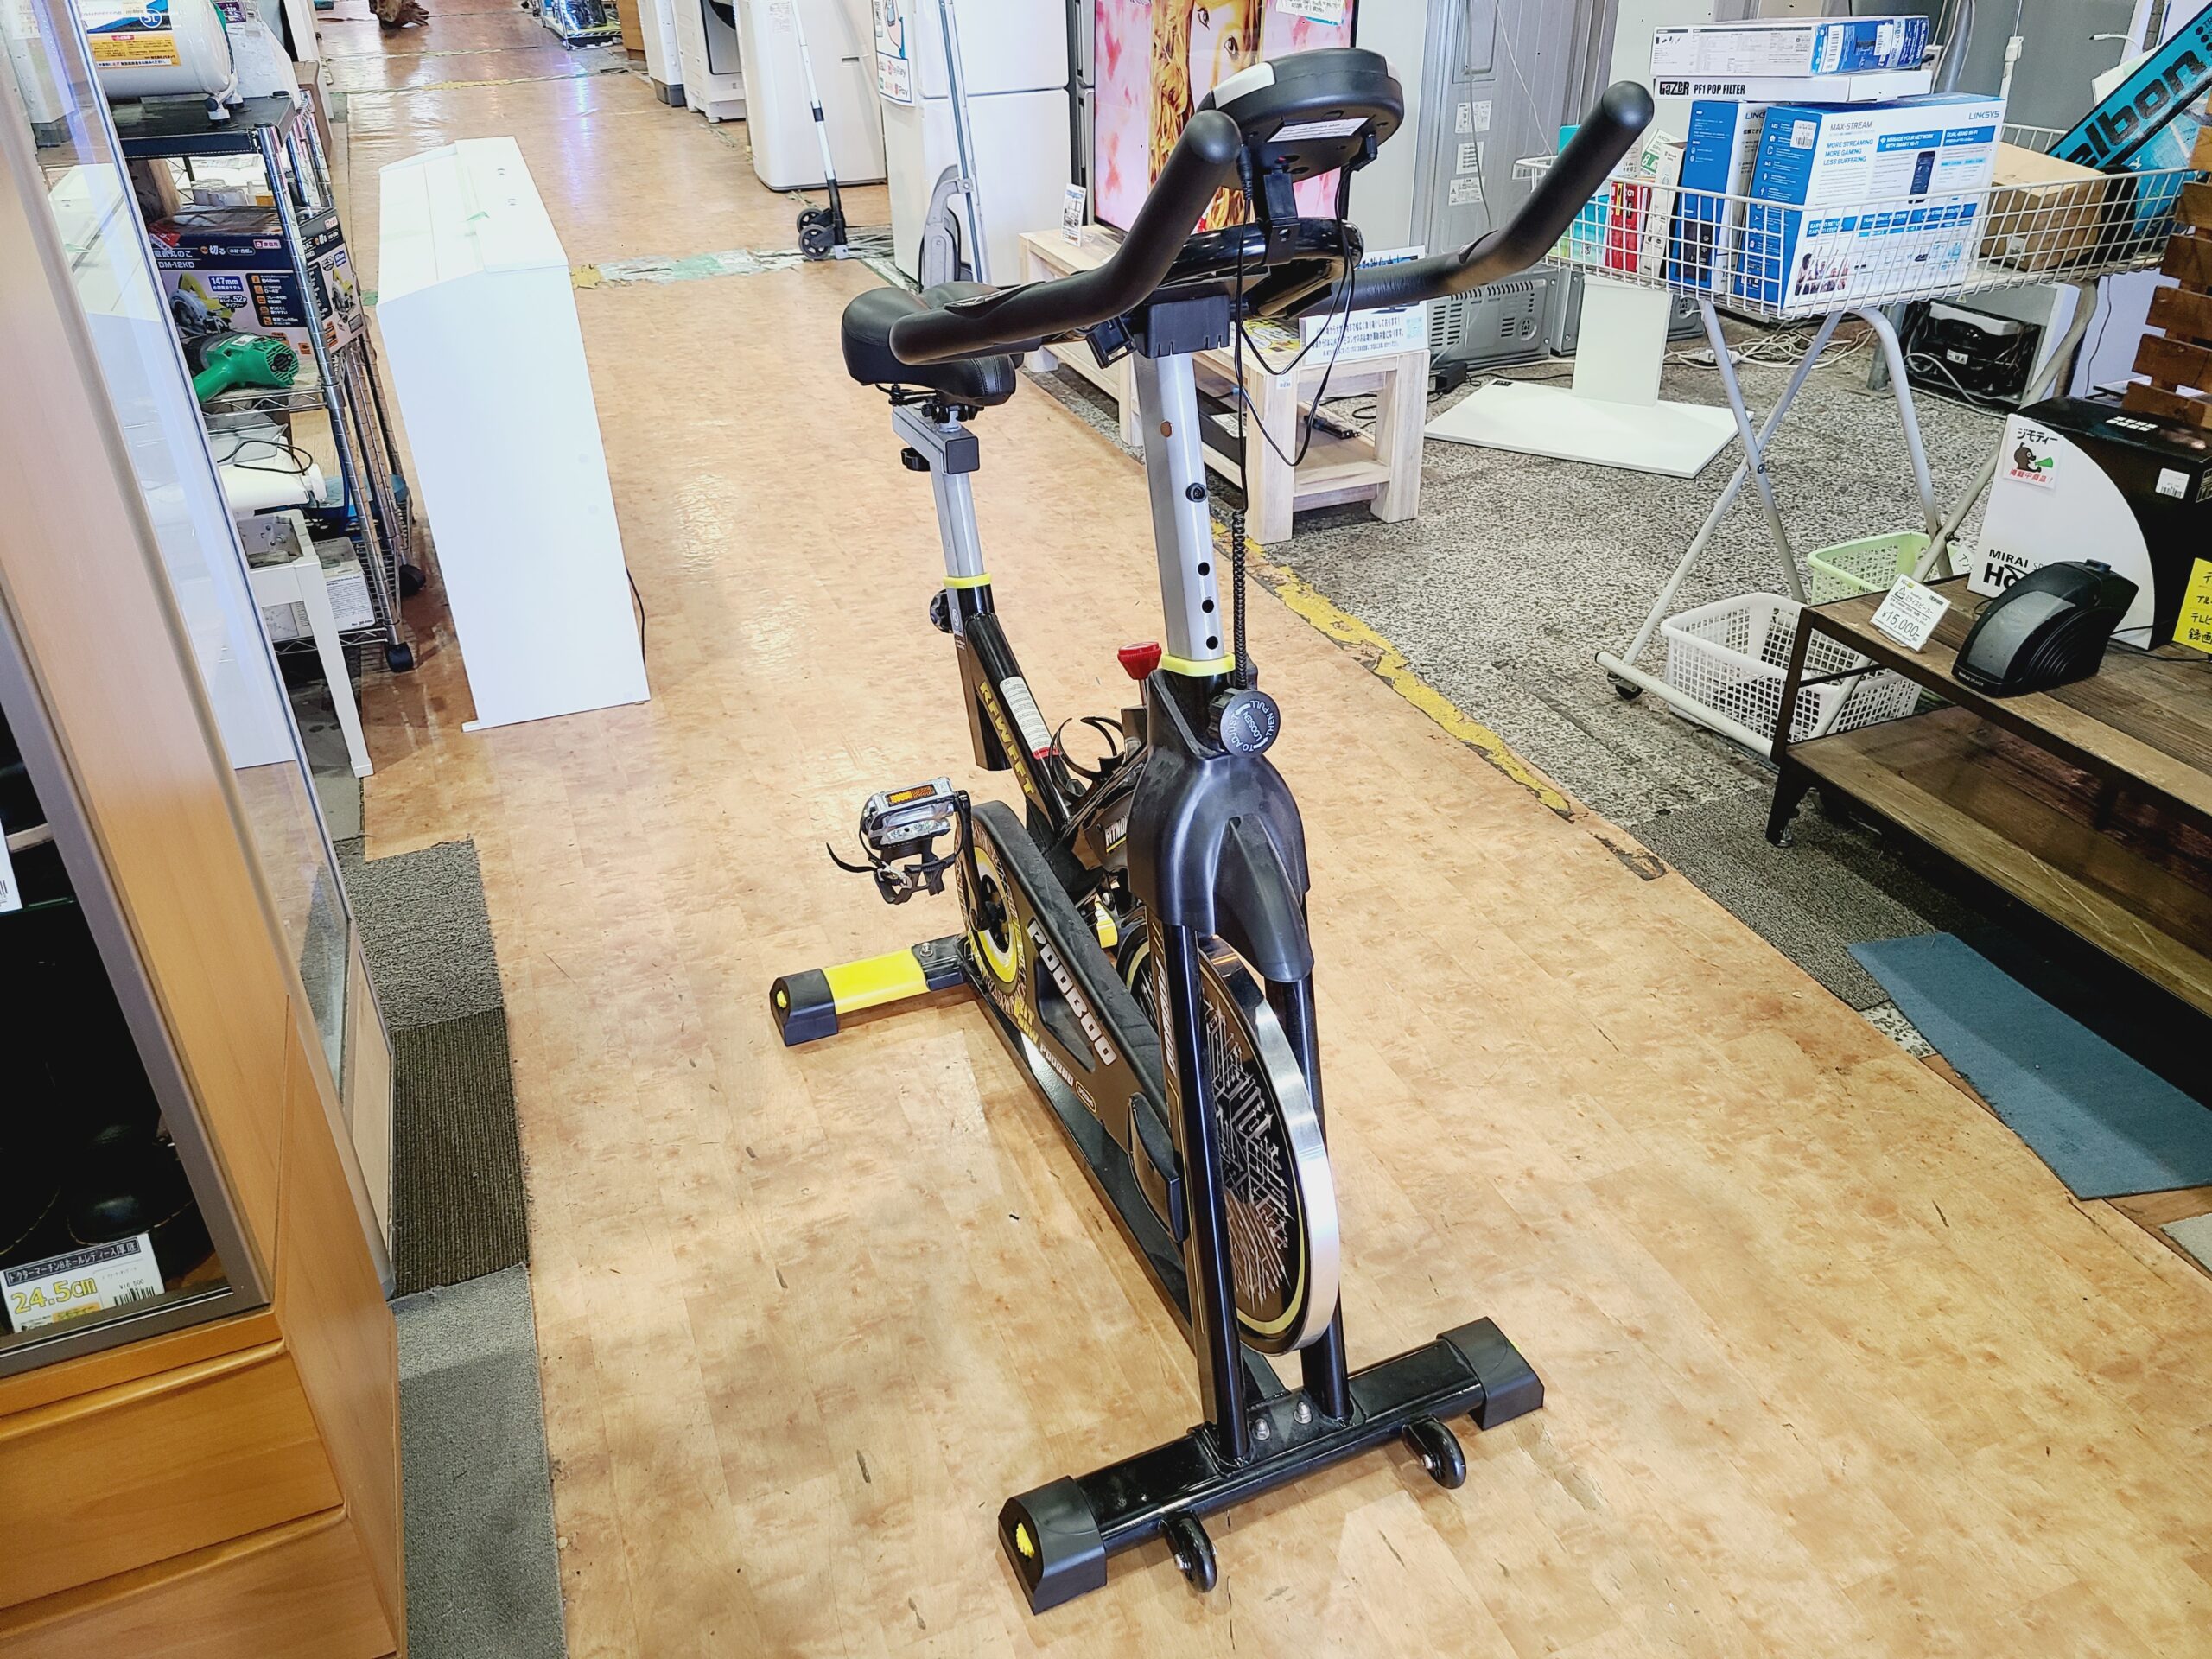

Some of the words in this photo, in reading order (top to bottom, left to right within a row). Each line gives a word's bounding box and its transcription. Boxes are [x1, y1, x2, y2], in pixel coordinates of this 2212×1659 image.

[1694, 84, 1706, 95] PF1
[1707, 84, 1722, 95] POP
[1723, 84, 1745, 95] FILTER
[1968, 111, 2000, 120] LINKSYS
[2053, 49, 2207, 169] elbon
[1829, 121, 1872, 131] MAX-STREAM
[1843, 138, 1873, 147] STREAMING
[1837, 156, 1866, 164] BUFFERING
[2017, 427, 2058, 445] ジモティー
[1988, 549, 2029, 569] MIRAI
[1249, 700, 1269, 714] PULL
[1228, 713, 1243, 747] ADJUST
[1243, 711, 1262, 741] LOOSEN
[1265, 712, 1275, 736] THEN
[1242, 743, 1254, 752] TO
[1027, 917, 1117, 1066] POOBOO
[1039, 1042, 1074, 1087] POOBOO
[11, 1276, 98, 1314] 24.5cm
